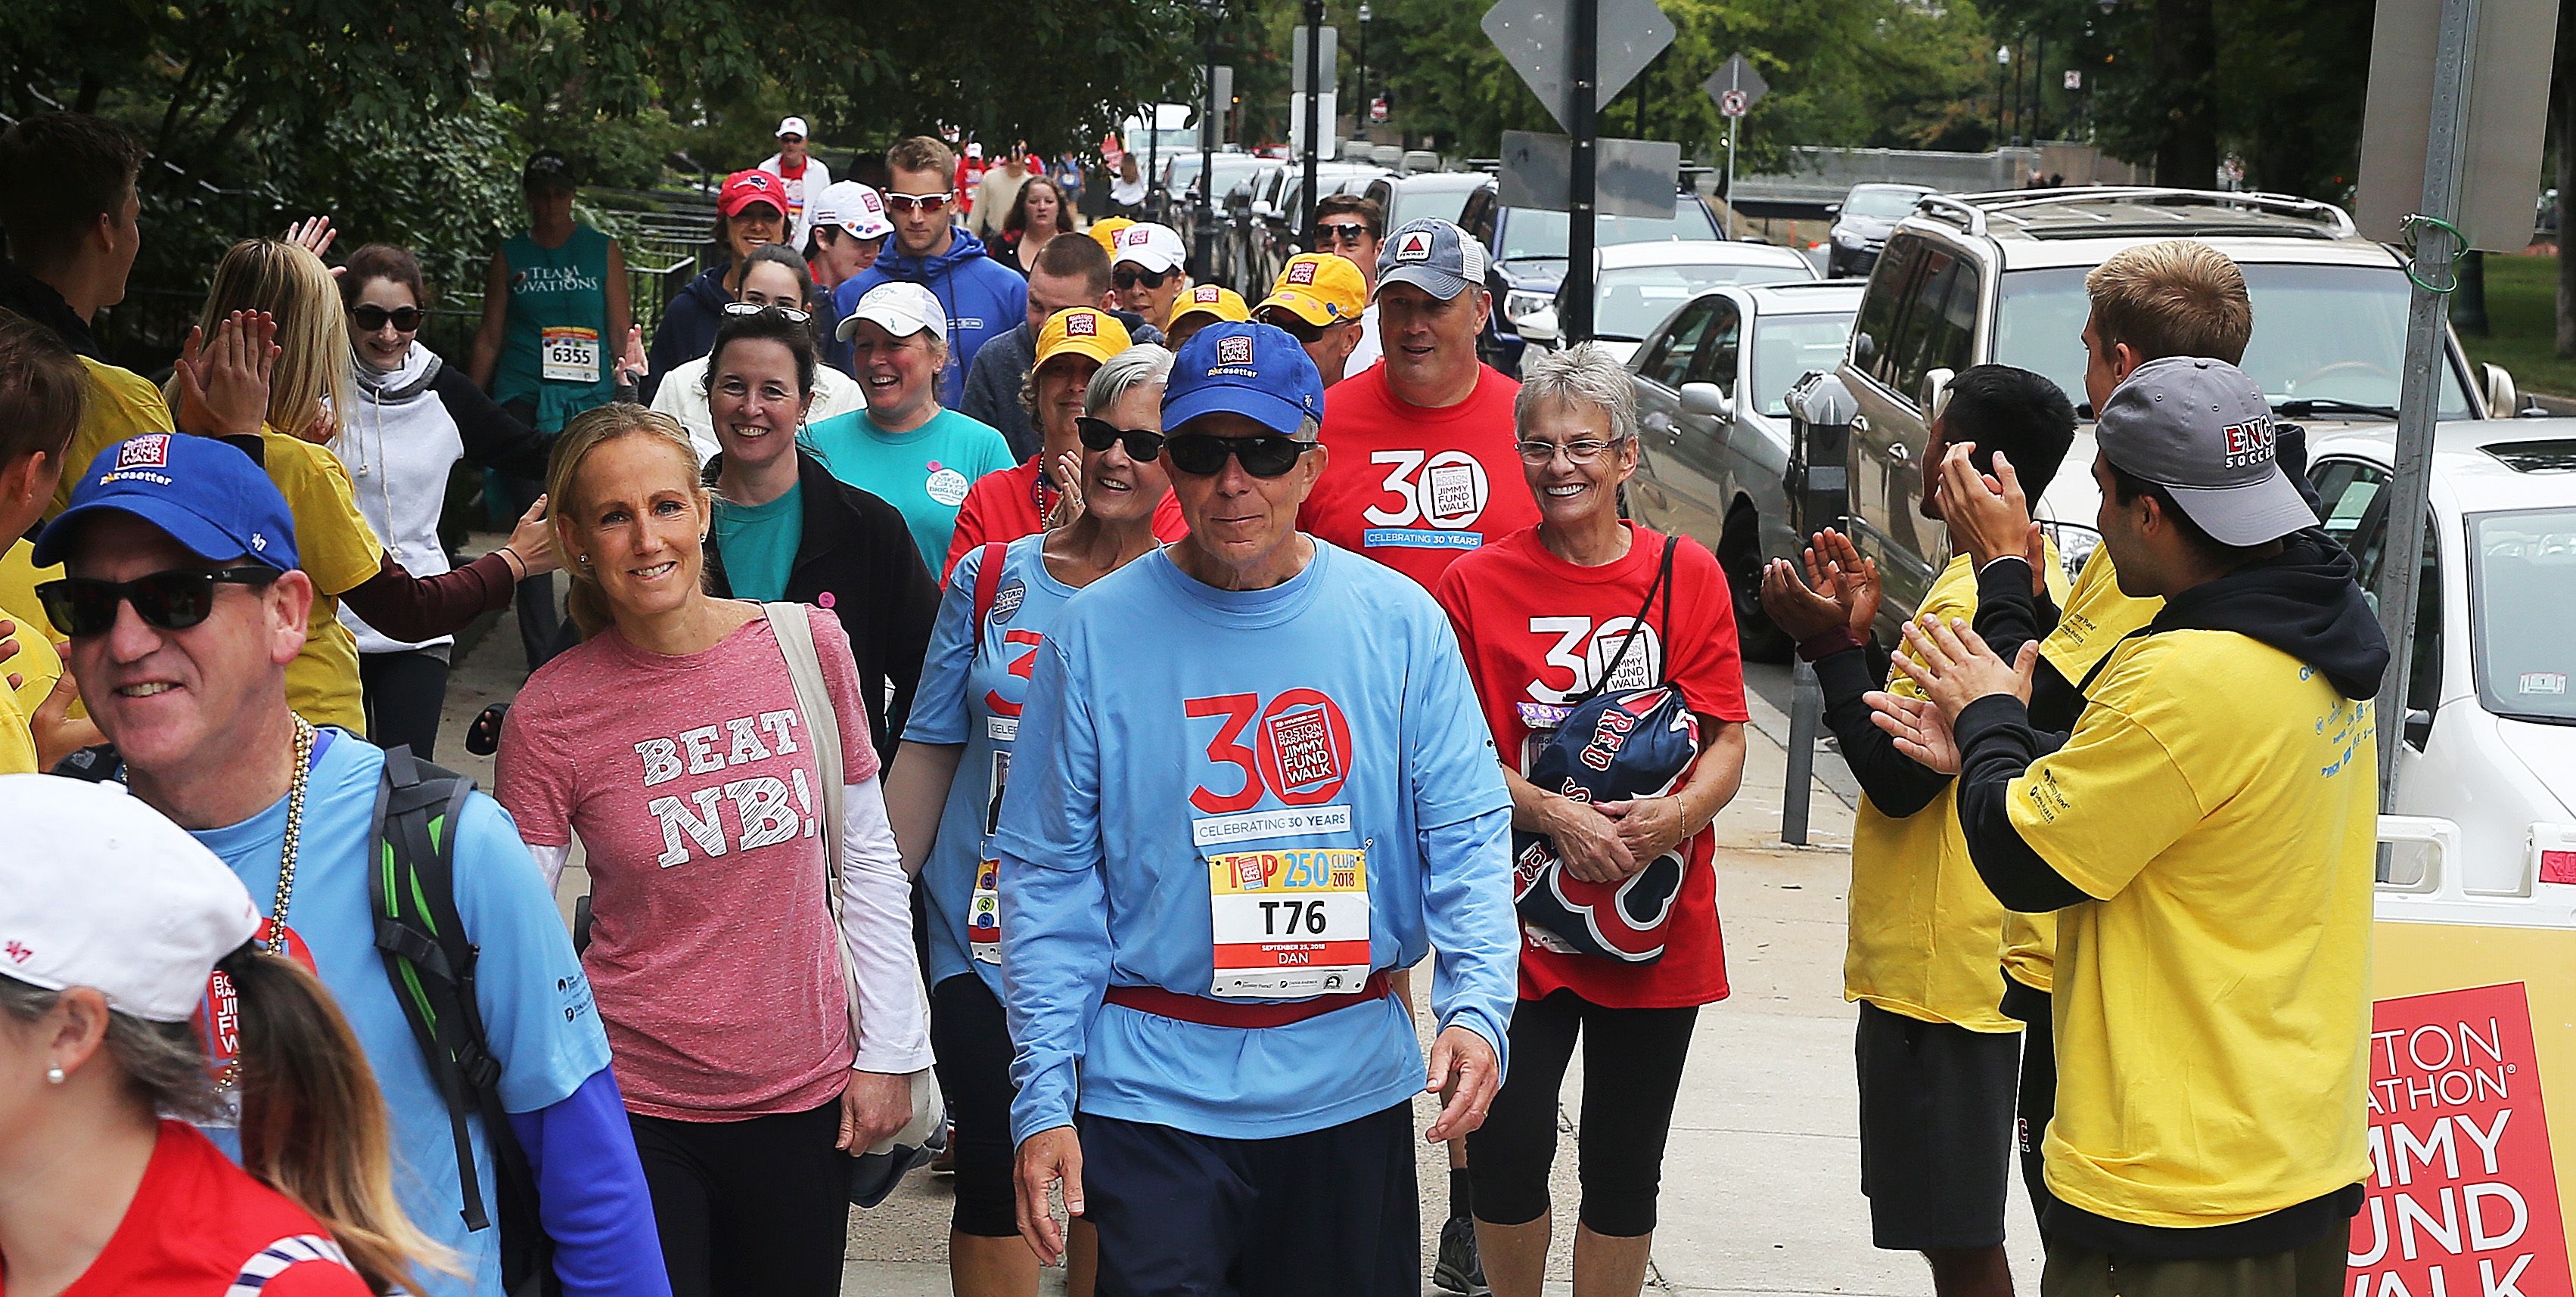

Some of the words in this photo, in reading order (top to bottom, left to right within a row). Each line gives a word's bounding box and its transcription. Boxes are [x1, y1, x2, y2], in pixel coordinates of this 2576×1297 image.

[531, 265, 580, 279] TEAM
[553, 348, 590, 364] 6355
[123, 454, 160, 464] WALK
[1363, 449, 1490, 529] 30
[1438, 485, 1468, 495] JIMMY
[1438, 492, 1469, 504] FUND
[1440, 501, 1470, 512] WALK
[1368, 534, 1431, 543] CELEBRATING
[1448, 536, 1478, 546] YEARS
[1611, 677, 1645, 689] WALK
[1277, 722, 1322, 741] BOSTON
[634, 709, 798, 787] BEAT
[1183, 687, 1353, 815] 30
[1283, 737, 1325, 759] JIMMY
[1283, 750, 1328, 771] FUND
[1286, 762, 1332, 783] WALK
[648, 768, 815, 869] NB!
[1199, 818, 1286, 838] CELEBRATING
[1288, 817, 1303, 828] 30
[1307, 814, 1346, 826] YEARS
[1284, 852, 1329, 888] 250
[1332, 854, 1356, 868] CLUB
[1333, 872, 1355, 887] 2018
[1259, 901, 1326, 934] T76
[1279, 952, 1309, 964] DAN
